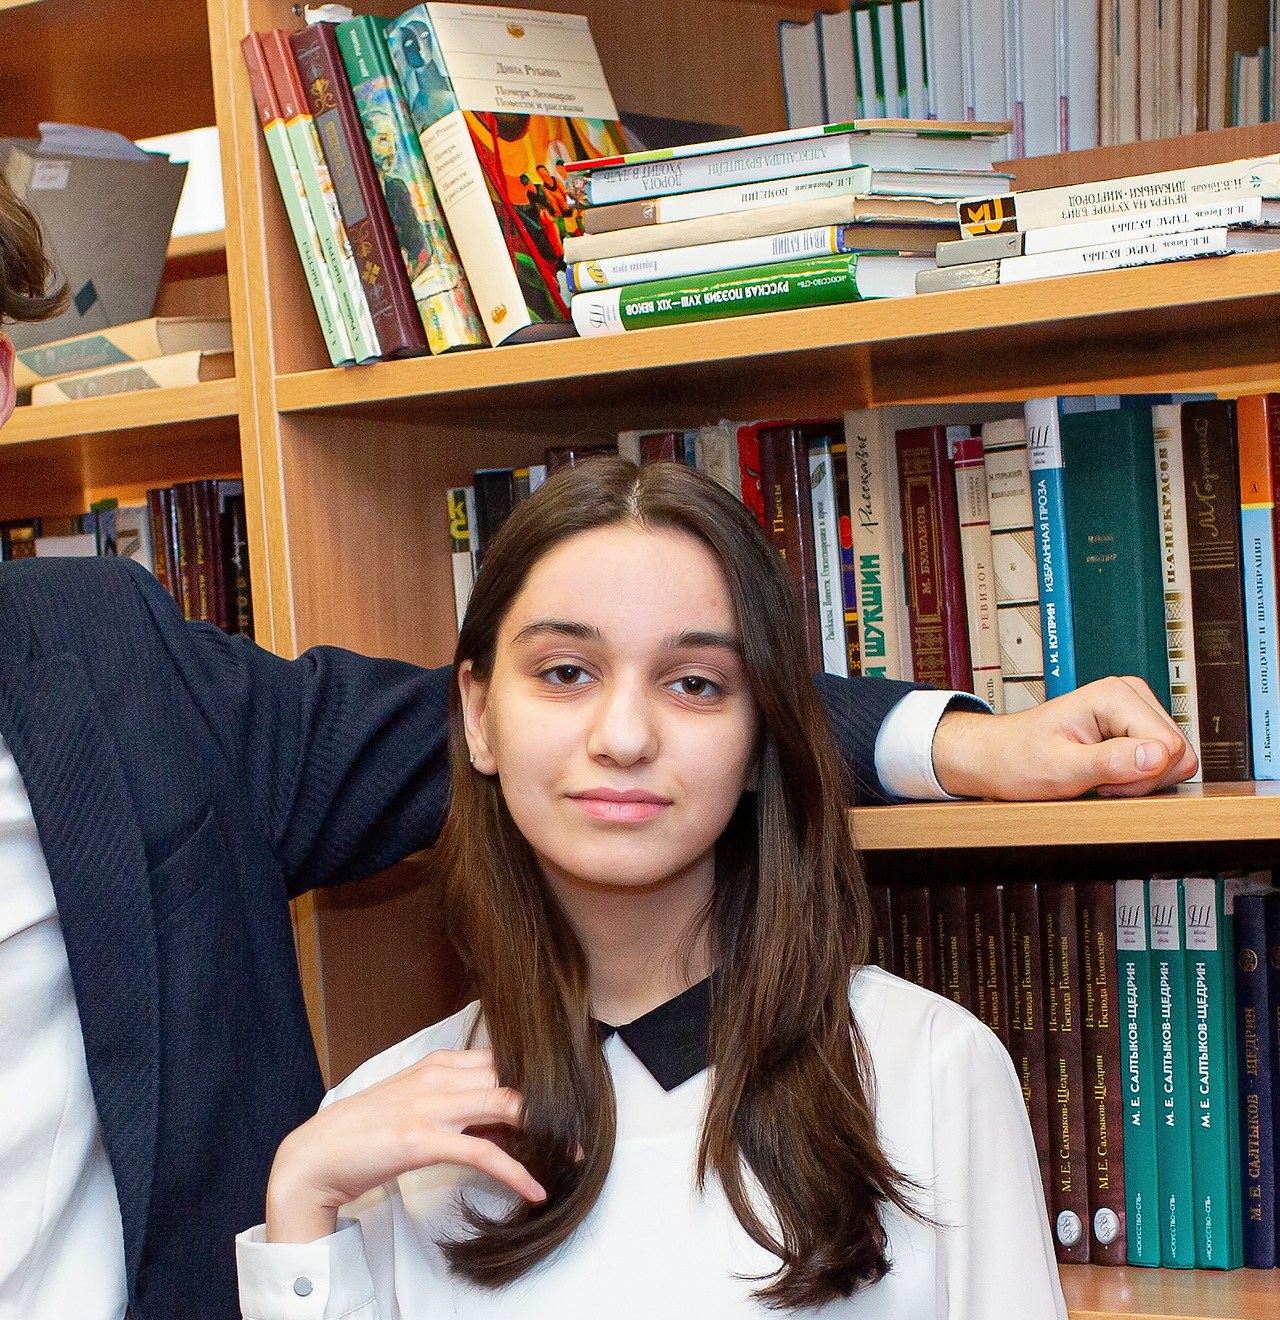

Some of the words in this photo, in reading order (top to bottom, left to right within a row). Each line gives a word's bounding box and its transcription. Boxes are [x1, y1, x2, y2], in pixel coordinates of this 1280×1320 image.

[765, 147, 827, 167] АЛЕКСАНДРА
[642, 162, 682, 179] УХОДИТ
[642, 173, 682, 192] ДОРОГА
[1091, 200, 1130, 216] ХУТОРЕ
[1133, 199, 1147, 209] НА
[1149, 193, 1188, 207] ВЕЧЕРА
[1061, 206, 1088, 220] БЛИЗ
[1158, 213, 1190, 227] ТАРАС
[1111, 219, 1152, 233] БУЛЬБА
[1082, 249, 1122, 263] БУЛЬБА
[1126, 243, 1158, 257] ТАРАС
[703, 287, 743, 305] ПОЭЗИЯ
[745, 281, 790, 299] РУССКАЯ
[625, 302, 655, 316] ВЕКОВ
[854, 435, 880, 535] Рассказы
[773, 483, 785, 533] Пьесы
[1037, 479, 1049, 521] ПРОЗА
[916, 505, 931, 576] БУЛГАКОВ
[1038, 522, 1055, 592] ИЗБРАННАЯ
[1253, 537, 1265, 622] ШВАМБРАНИЯ
[859, 553, 886, 658] ШУКШИН
[976, 562, 990, 631] РЕВИЗОР
[1045, 602, 1058, 649] КУПРИН
[1049, 651, 1059, 663] И.
[1051, 664, 1061, 678] А.
[1259, 640, 1269, 695] КОНДУИТ
[985, 678, 995, 711] ОГОЛЬ
[1263, 708, 1271, 746] Кассиль
[987, 935, 998, 989] Головлевы
[1022, 935, 1032, 989] Головлевы
[1059, 936, 1070, 990] Головлевы
[1096, 932, 1107, 986] Головлевы
[1023, 991, 1033, 1031] Господа
[1049, 989, 1058, 1032] История
[1061, 991, 1072, 1032] Господа
[1086, 983, 1094, 1028] История
[1098, 988, 1109, 1028] Господа
[1126, 962, 1140, 1093] САЛТЫКОВ-ЩЕДРИН
[1159, 962, 1174, 1093] САЛТЫКОВ-ЩЕДРИН
[1195, 962, 1210, 1094] САЛТЫКОВ-ЩЕДРИН
[1057, 1058, 1071, 1159] Салтыков-Щедрин
[1094, 1055, 1108, 1156] Салтыков-Щедрин
[1131, 1096, 1141, 1107] Е.
[1164, 1097, 1174, 1107] Е.
[1200, 1098, 1210, 1108] Е.
[1131, 1110, 1141, 1126] М.
[1165, 1111, 1175, 1127] М.
[1200, 1112, 1211, 1128] М.
[1060, 1160, 1071, 1175] Е.
[1097, 1159, 1108, 1173] Е.
[1061, 1177, 1072, 1192] М.
[1098, 1174, 1109, 1190] М.
[1249, 1184, 1261, 1198] Е.
[1250, 1204, 1262, 1221] М.
